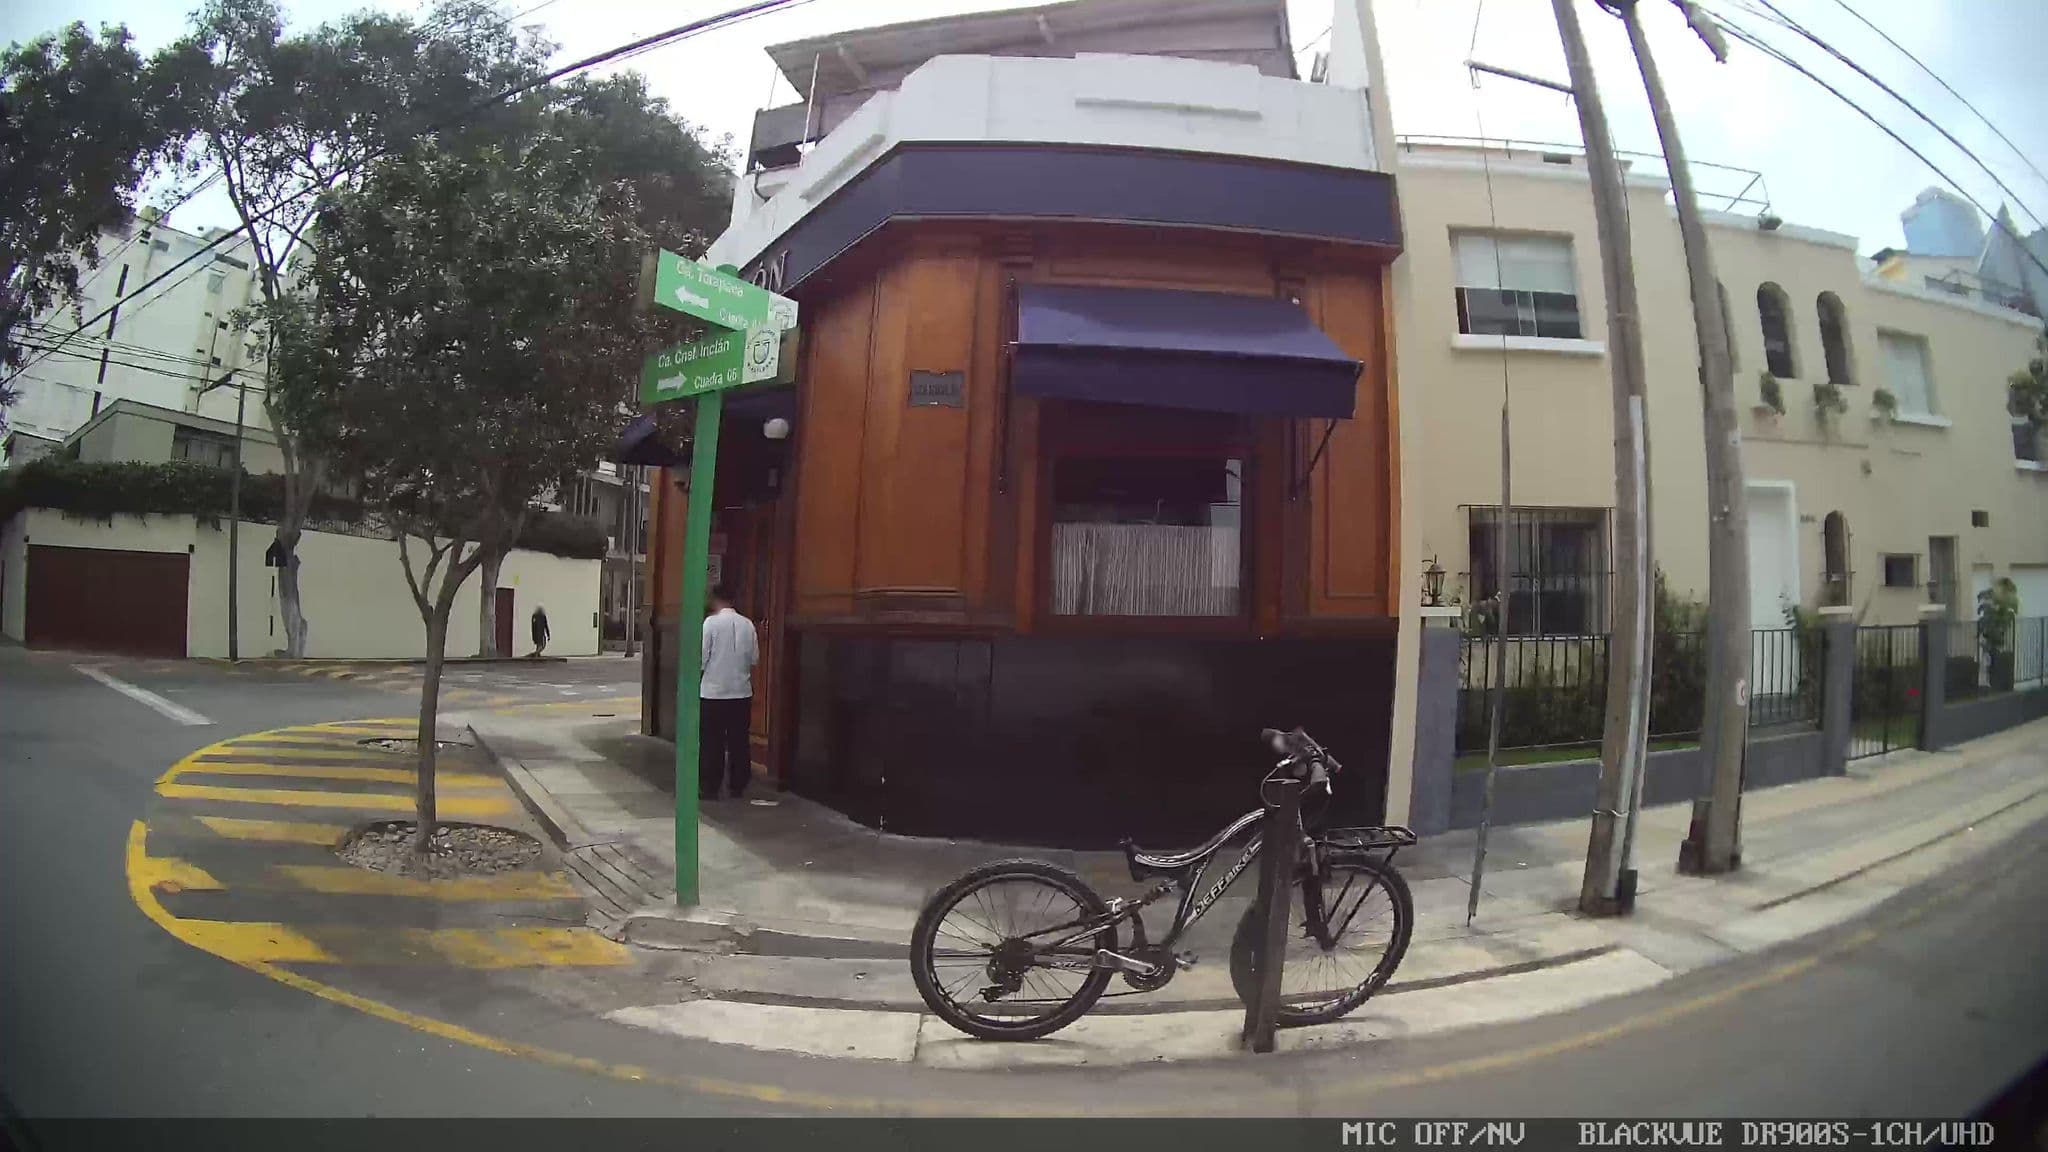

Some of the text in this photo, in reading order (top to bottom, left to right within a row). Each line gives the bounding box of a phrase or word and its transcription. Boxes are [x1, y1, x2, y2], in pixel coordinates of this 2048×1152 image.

[658, 354, 673, 368] Ca.
[700, 338, 730, 358] Inclán
[694, 371, 723, 389] Cuadra
